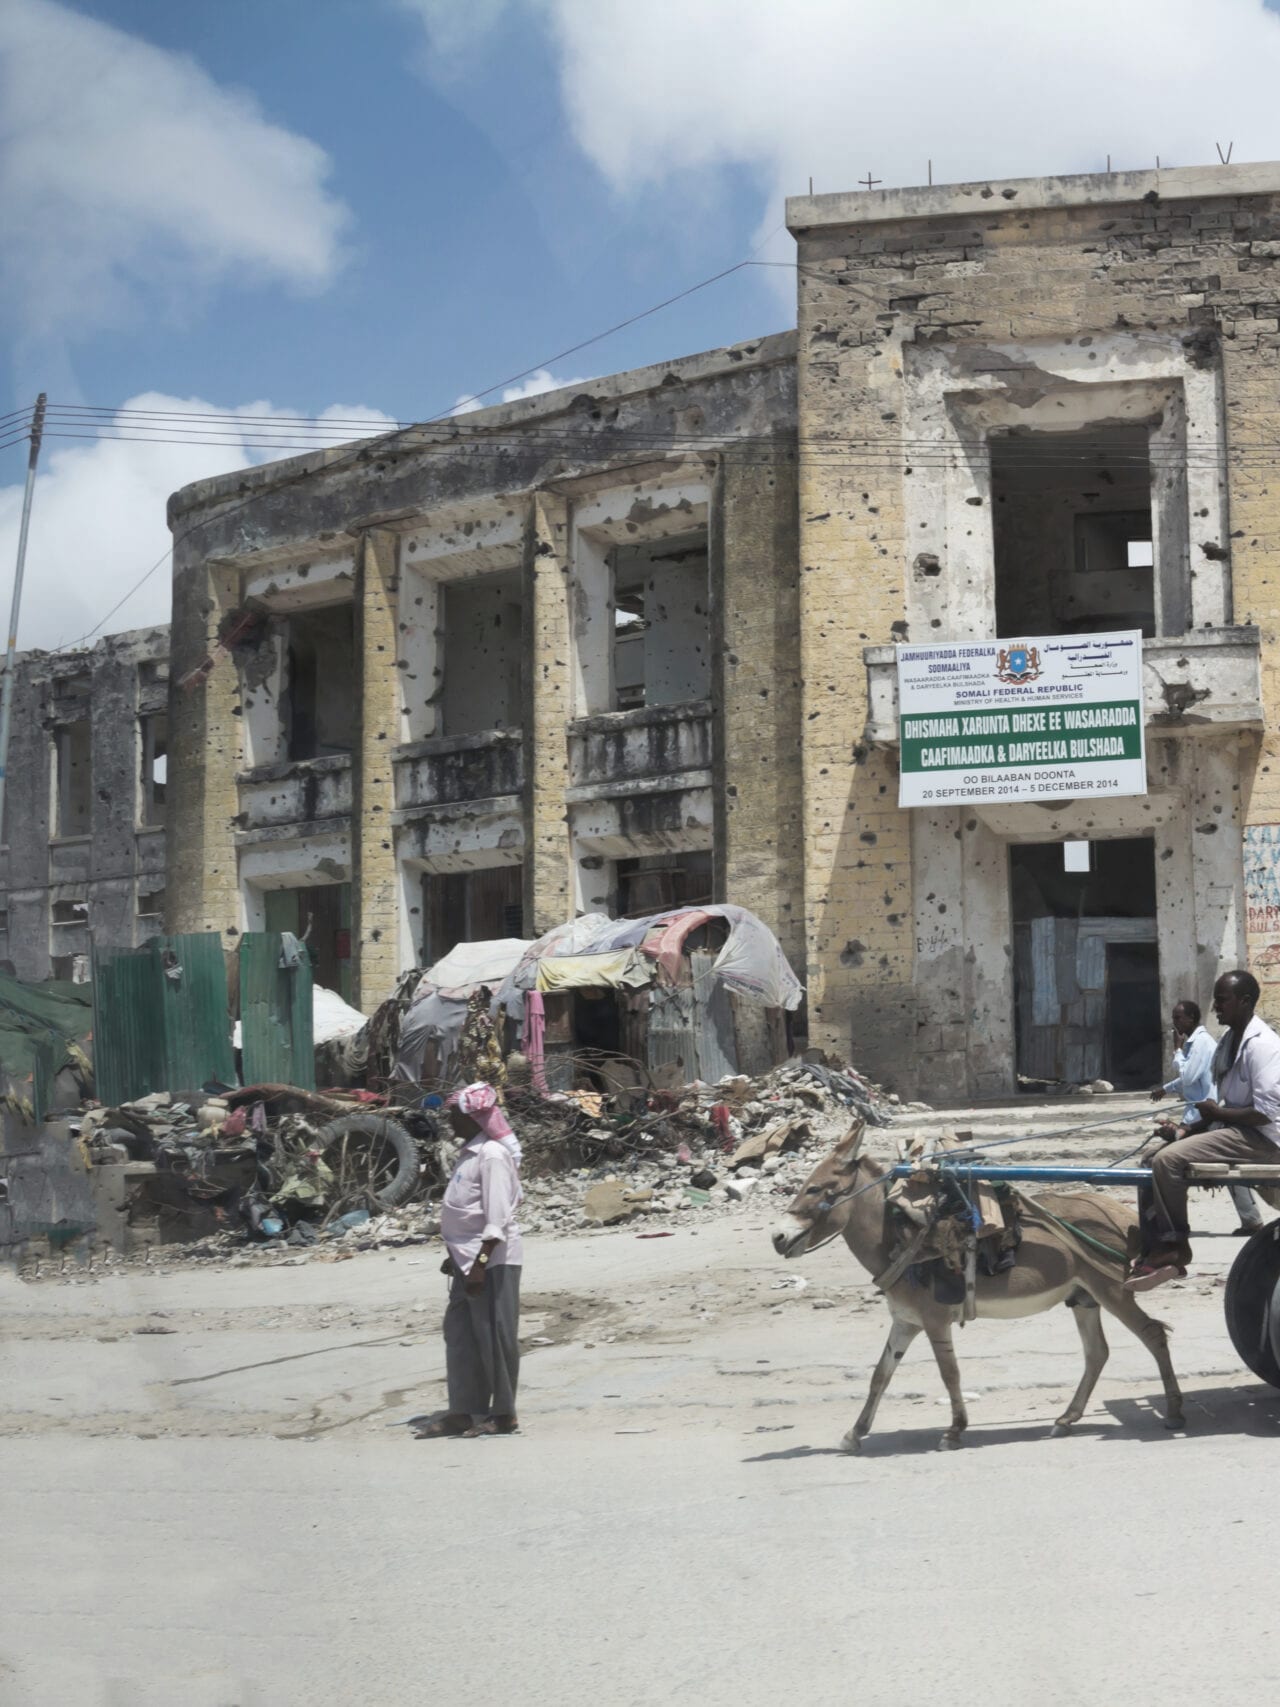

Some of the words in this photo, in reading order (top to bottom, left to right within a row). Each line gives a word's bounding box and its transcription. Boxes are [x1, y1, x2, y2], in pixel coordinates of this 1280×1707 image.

[959, 647, 996, 658] FEDERALKA
[928, 662, 971, 673] SOOMAALIYA
[947, 673, 990, 681] CAAFIMAADKA
[916, 682, 951, 690] DARYEELKA
[953, 680, 985, 688] BULSHADA
[956, 690, 990, 699] SOMALI
[993, 686, 1034, 696] FEDERAL
[1038, 684, 1083, 693] REPUBLIC
[954, 698, 982, 706] MINISTRY
[905, 717, 960, 739] DHISMAHA
[961, 715, 1010, 736] XARUNTA
[1012, 712, 1046, 733] DHEXE
[1049, 711, 1061, 731] EE
[1064, 706, 1136, 730] WASAARADDA
[921, 744, 995, 767] CAAFIMAADKA
[997, 744, 1006, 762] &
[1009, 740, 1068, 762] DARYEELKA
[1070, 736, 1125, 758] BULSHADA
[963, 775, 978, 784] OO
[981, 773, 1031, 784] BILAABAN
[1034, 770, 1075, 780] DOONTA
[922, 790, 933, 799] 20
[935, 787, 995, 798] SEPTEMBER
[997, 785, 1020, 795] 2014
[1030, 783, 1036, 793] 5
[1038, 780, 1094, 792] DECEMBER
[1096, 779, 1119, 789] 2014
